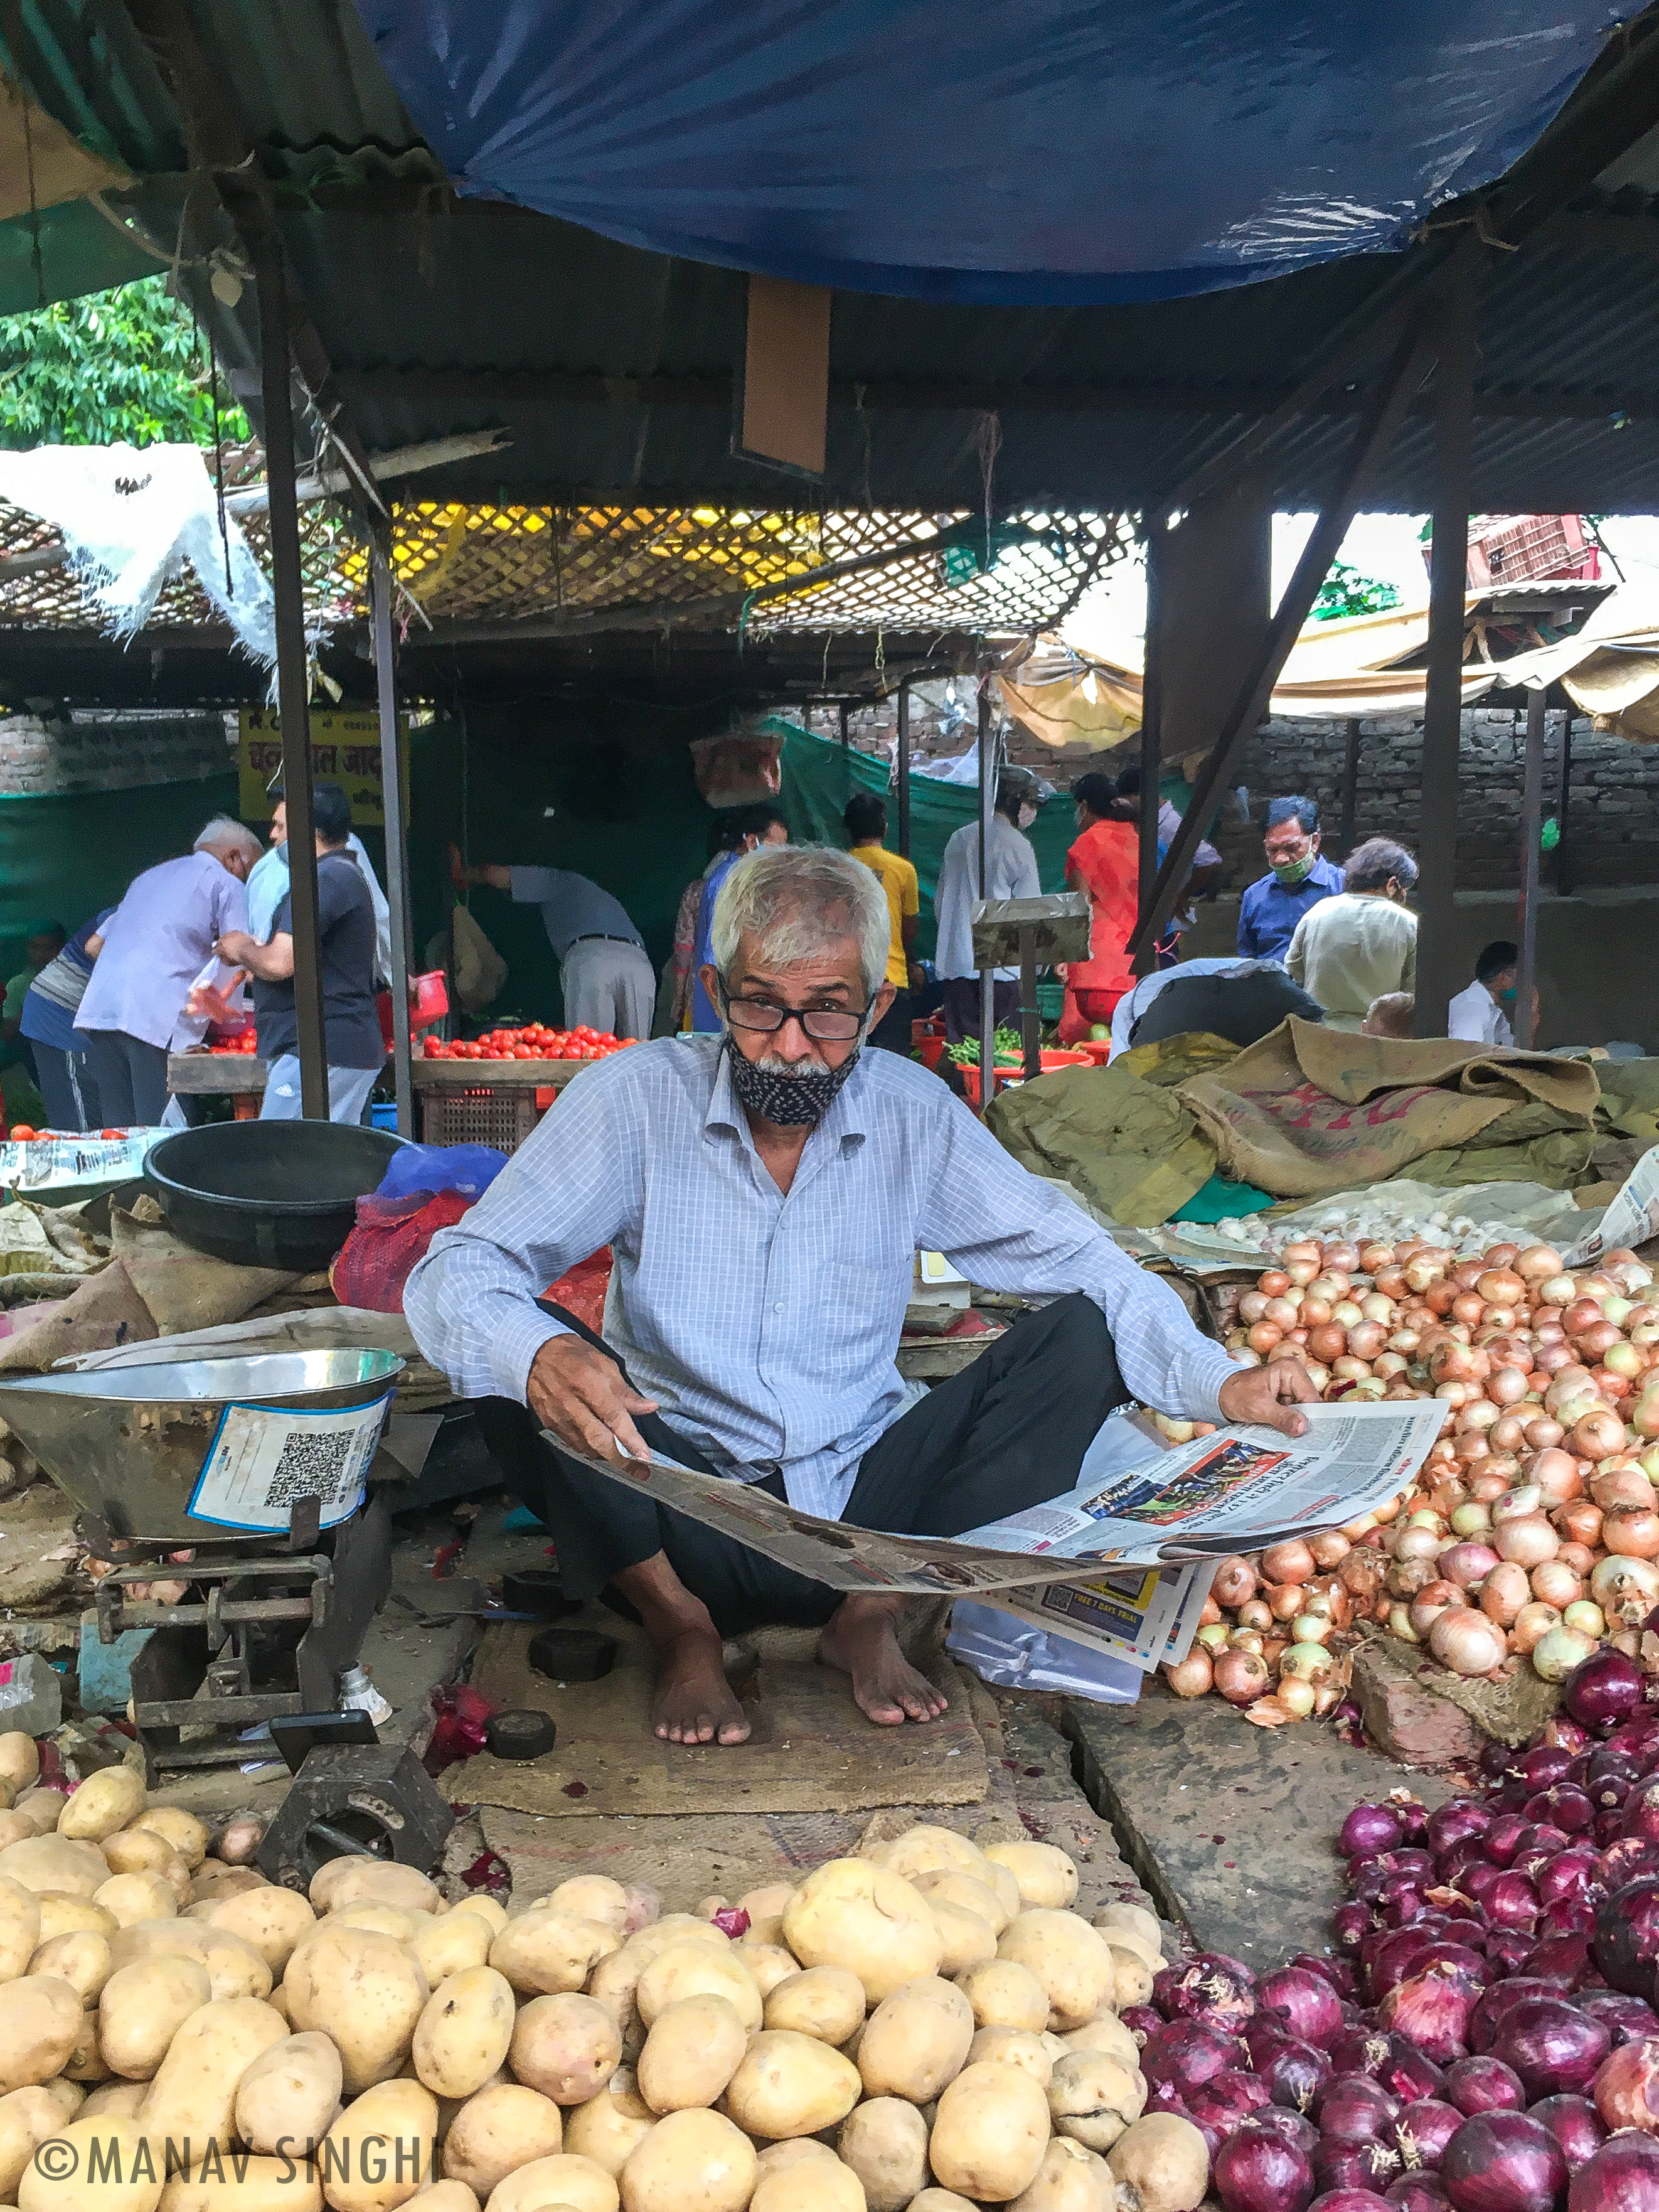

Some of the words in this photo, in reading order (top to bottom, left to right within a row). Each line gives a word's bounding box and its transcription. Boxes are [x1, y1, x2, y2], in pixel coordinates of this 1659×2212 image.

[1228, 1500, 1248, 1512] 137
[1074, 1593, 1091, 1606] FREE
[1092, 1600, 1098, 1608] 7
[1099, 1603, 1116, 1616] DAYS
[1118, 1610, 1138, 1623] TRIAL
